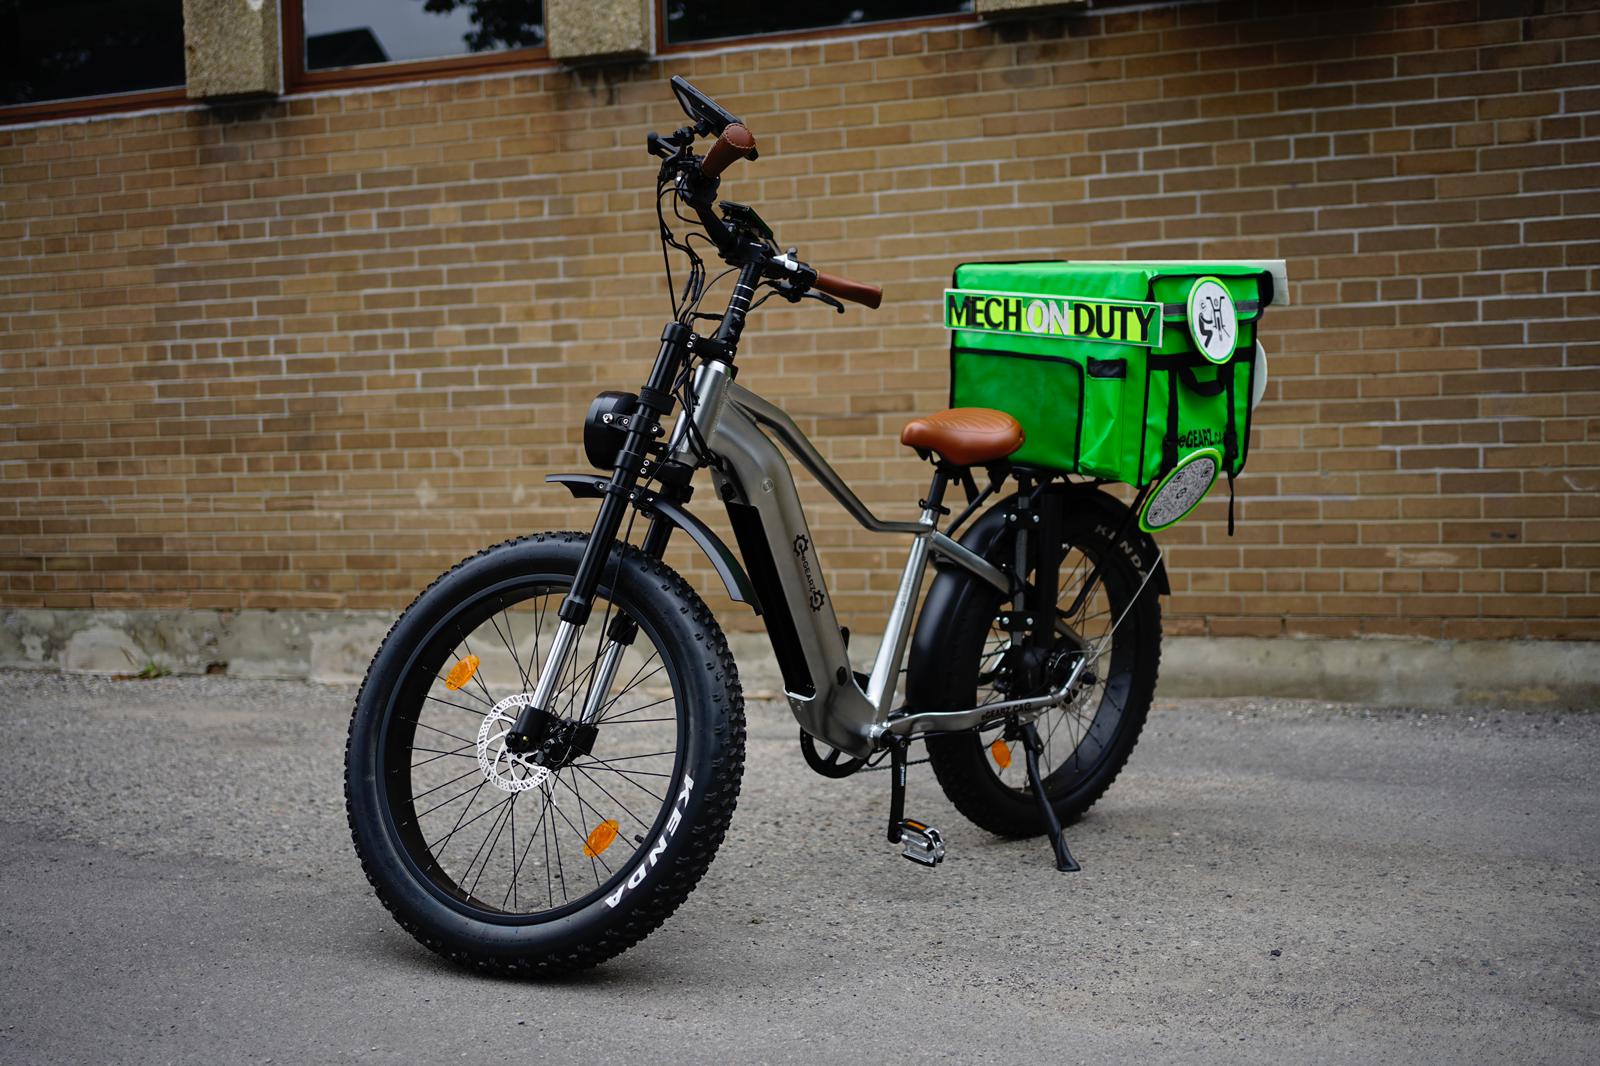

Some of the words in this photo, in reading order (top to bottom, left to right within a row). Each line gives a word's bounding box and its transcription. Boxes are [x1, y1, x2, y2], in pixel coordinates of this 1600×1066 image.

[949, 294, 1022, 331] MECH
[1026, 299, 1070, 336] ON
[1073, 303, 1156, 341] DUTY
[604, 774, 695, 909] KENDA
